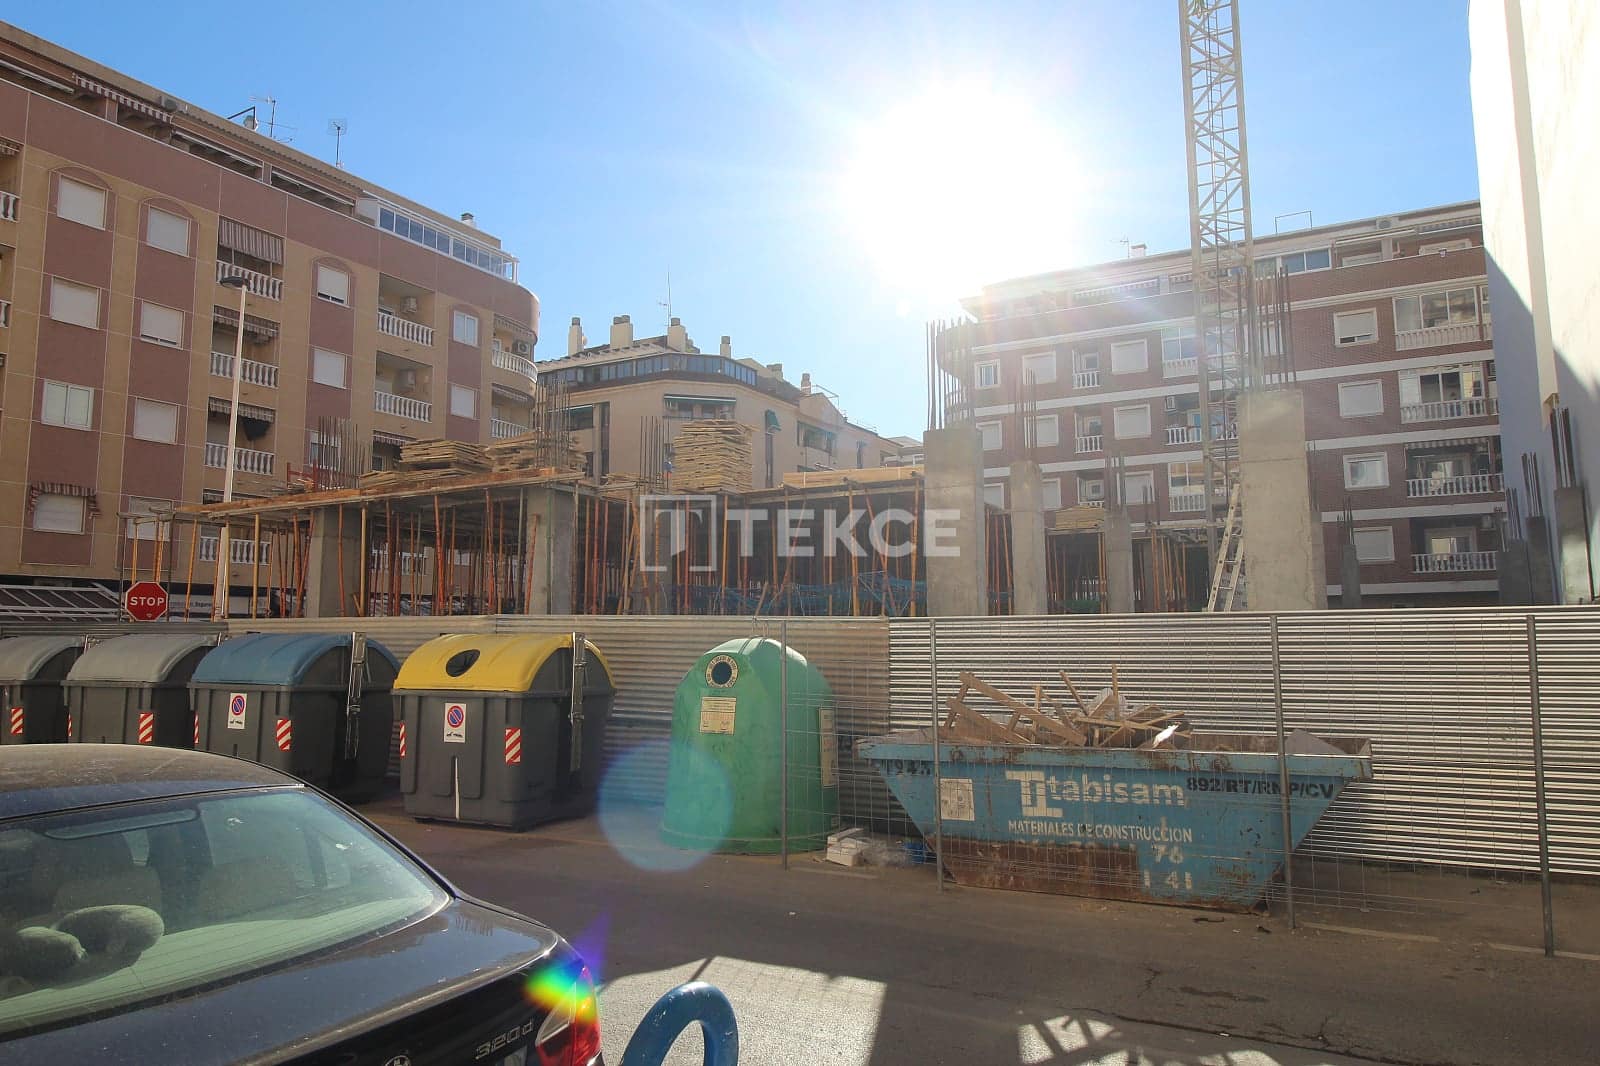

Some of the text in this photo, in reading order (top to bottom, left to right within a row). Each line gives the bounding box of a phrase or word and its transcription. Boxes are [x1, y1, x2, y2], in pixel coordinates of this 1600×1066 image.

[130, 597, 164, 606] STOP
[1046, 773, 1186, 807] tabisam
[1008, 820, 1073, 837] MATERIALES
[1095, 822, 1193, 843] CONSTRUCCION
[476, 1019, 533, 1059] 320d
